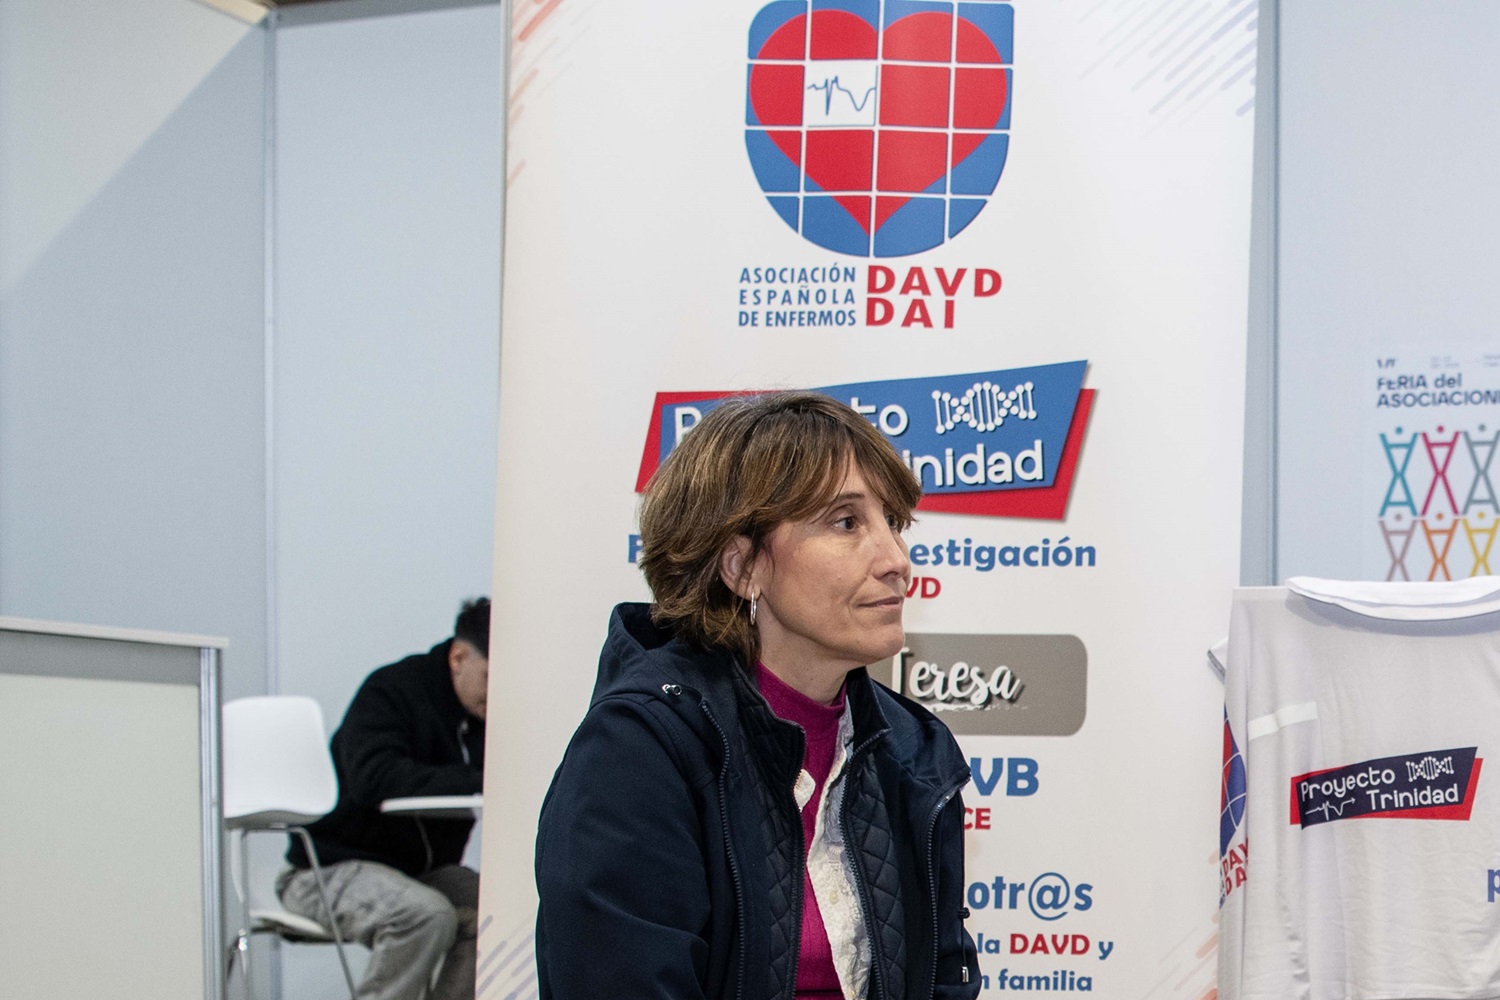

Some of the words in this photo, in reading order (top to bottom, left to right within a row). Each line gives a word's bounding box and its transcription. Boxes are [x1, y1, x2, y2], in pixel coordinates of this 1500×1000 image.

[739, 262, 856, 284] ASOCIACIÓN
[867, 265, 1003, 297] DAVD
[739, 284, 856, 306] ESPAÑOLA
[738, 311, 759, 327] DE
[765, 310, 857, 327] ENFERMOS
[865, 297, 955, 329] DAI
[1434, 373, 1463, 389] del
[902, 439, 1044, 487] inidad
[910, 536, 1097, 572] estigación
[970, 757, 1040, 797] VB
[1300, 766, 1396, 803] Proyecto
[1366, 783, 1459, 811] Trinidad
[1009, 933, 1091, 955] DAVD
[1098, 940, 1114, 960] y
[998, 968, 1093, 991] familia
